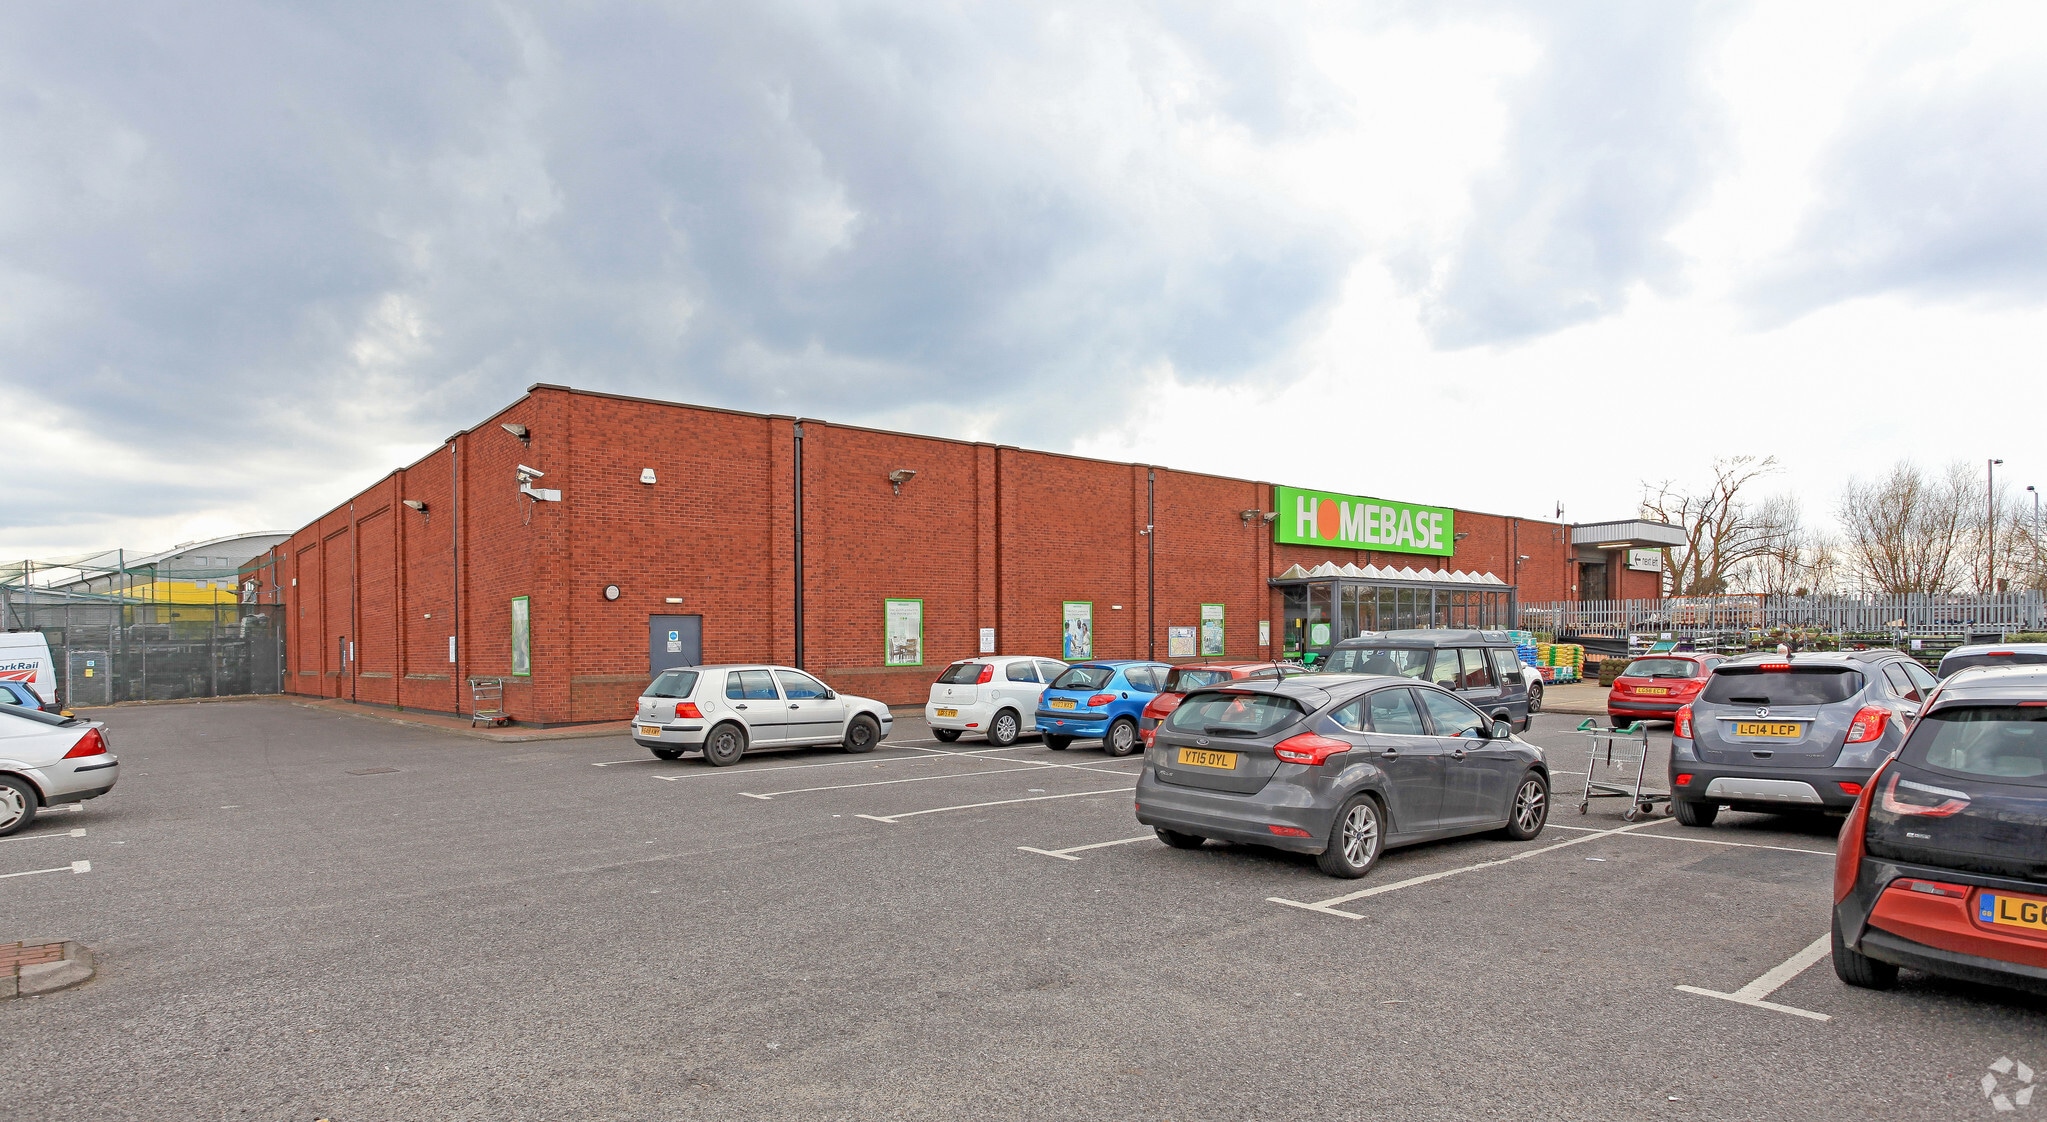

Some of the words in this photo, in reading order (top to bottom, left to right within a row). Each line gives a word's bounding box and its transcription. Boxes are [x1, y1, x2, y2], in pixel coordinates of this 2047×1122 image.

[1296, 495, 1443, 550] HOMEBASE
[1740, 724, 1767, 735] LC14
[1771, 725, 1796, 735] LCP
[1185, 750, 1207, 765] YT15
[1208, 753, 1228, 767] OYL
